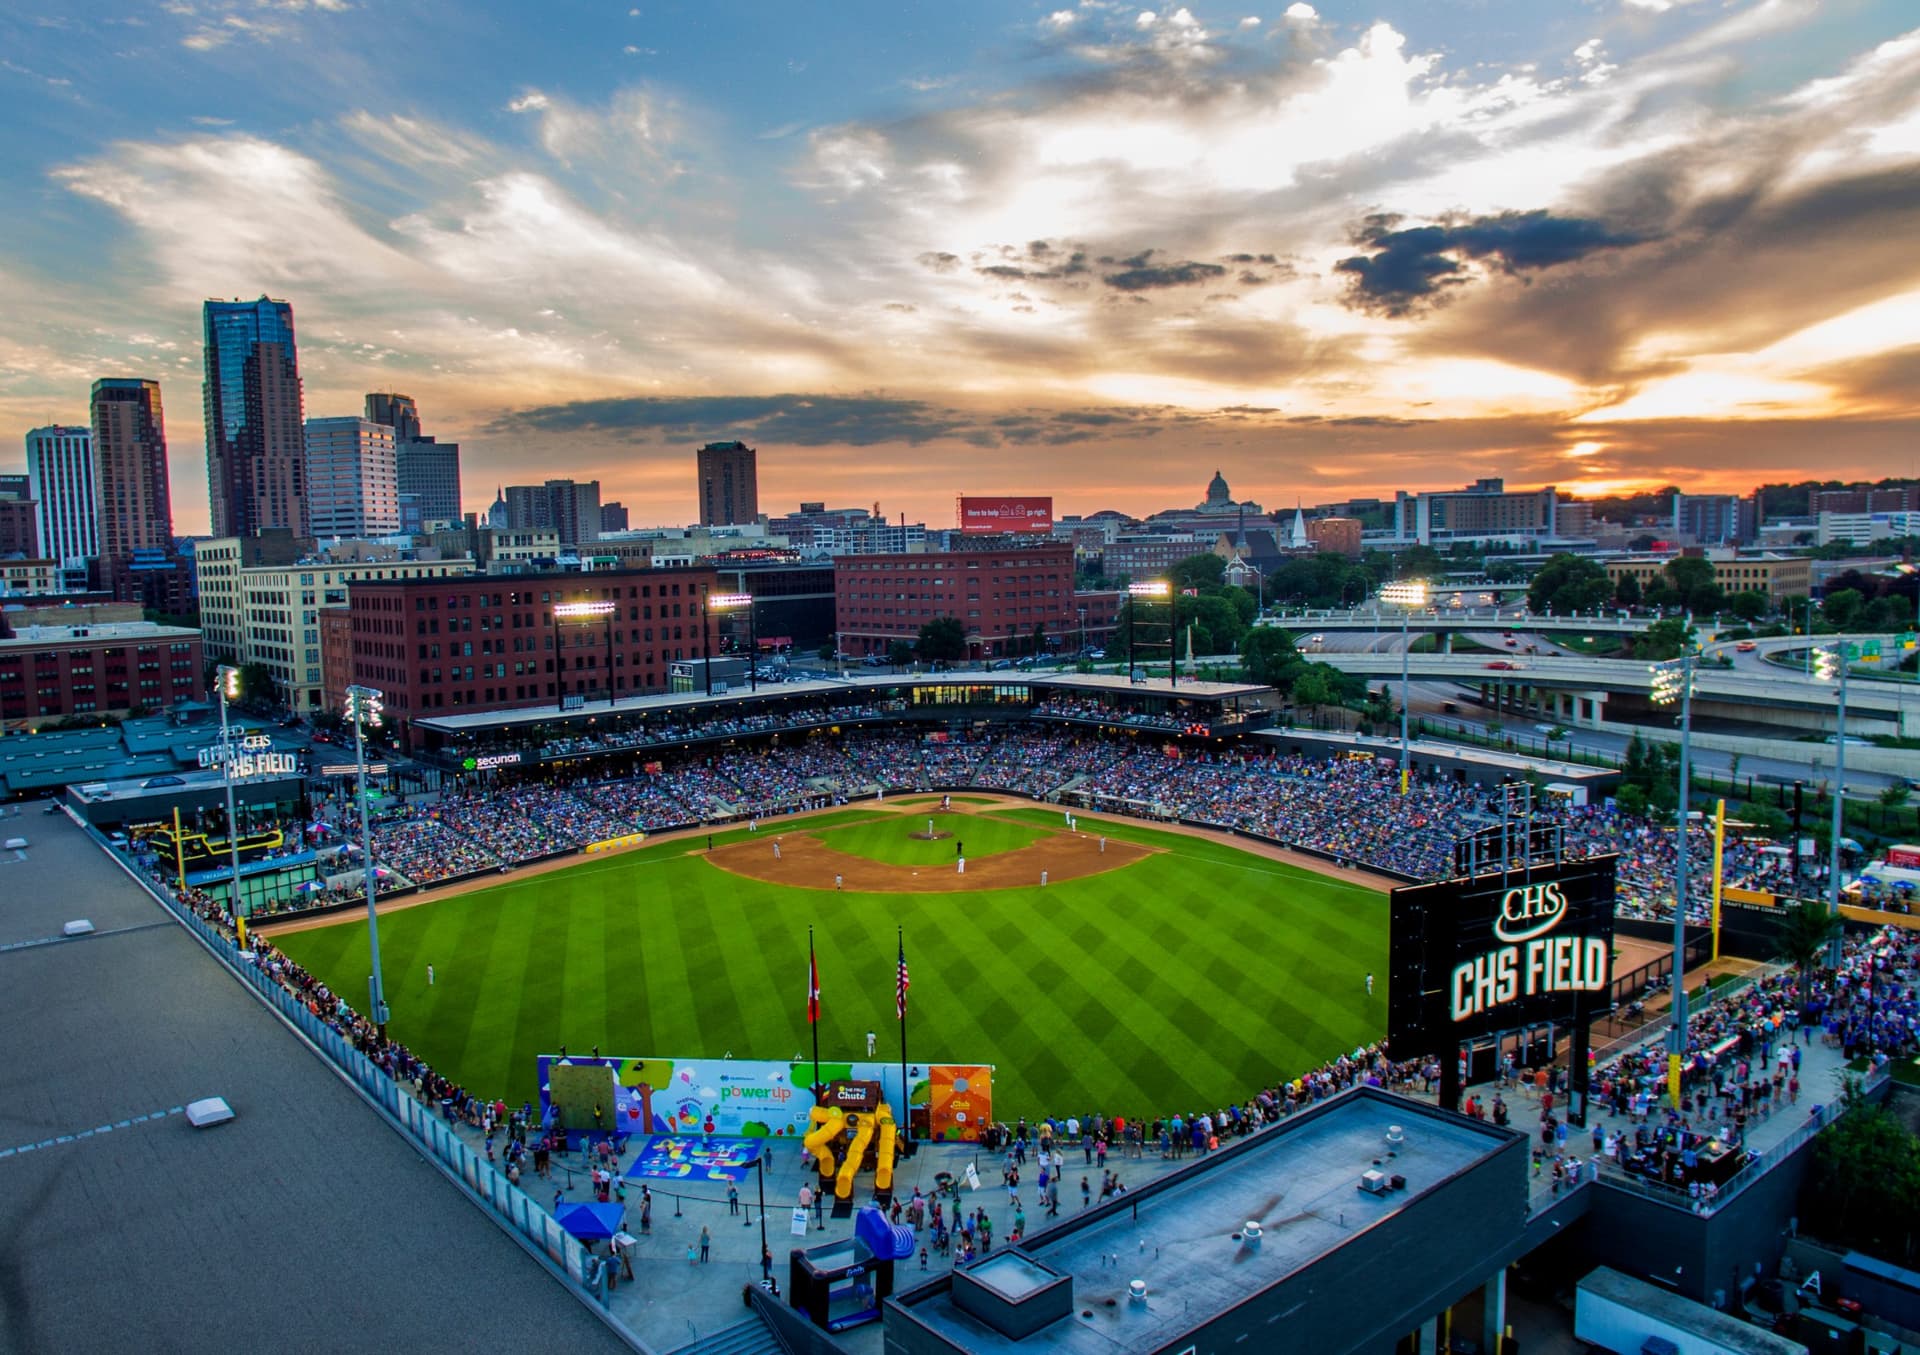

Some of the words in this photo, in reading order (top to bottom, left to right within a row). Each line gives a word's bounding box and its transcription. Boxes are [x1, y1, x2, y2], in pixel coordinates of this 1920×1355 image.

[244, 734, 272, 749] CHS
[257, 753, 297, 774] FIELD
[1503, 882, 1561, 921] CHS
[1452, 945, 1519, 1022] CHS
[1526, 936, 1608, 996] FIELD
[837, 1091, 866, 1100] Chute
